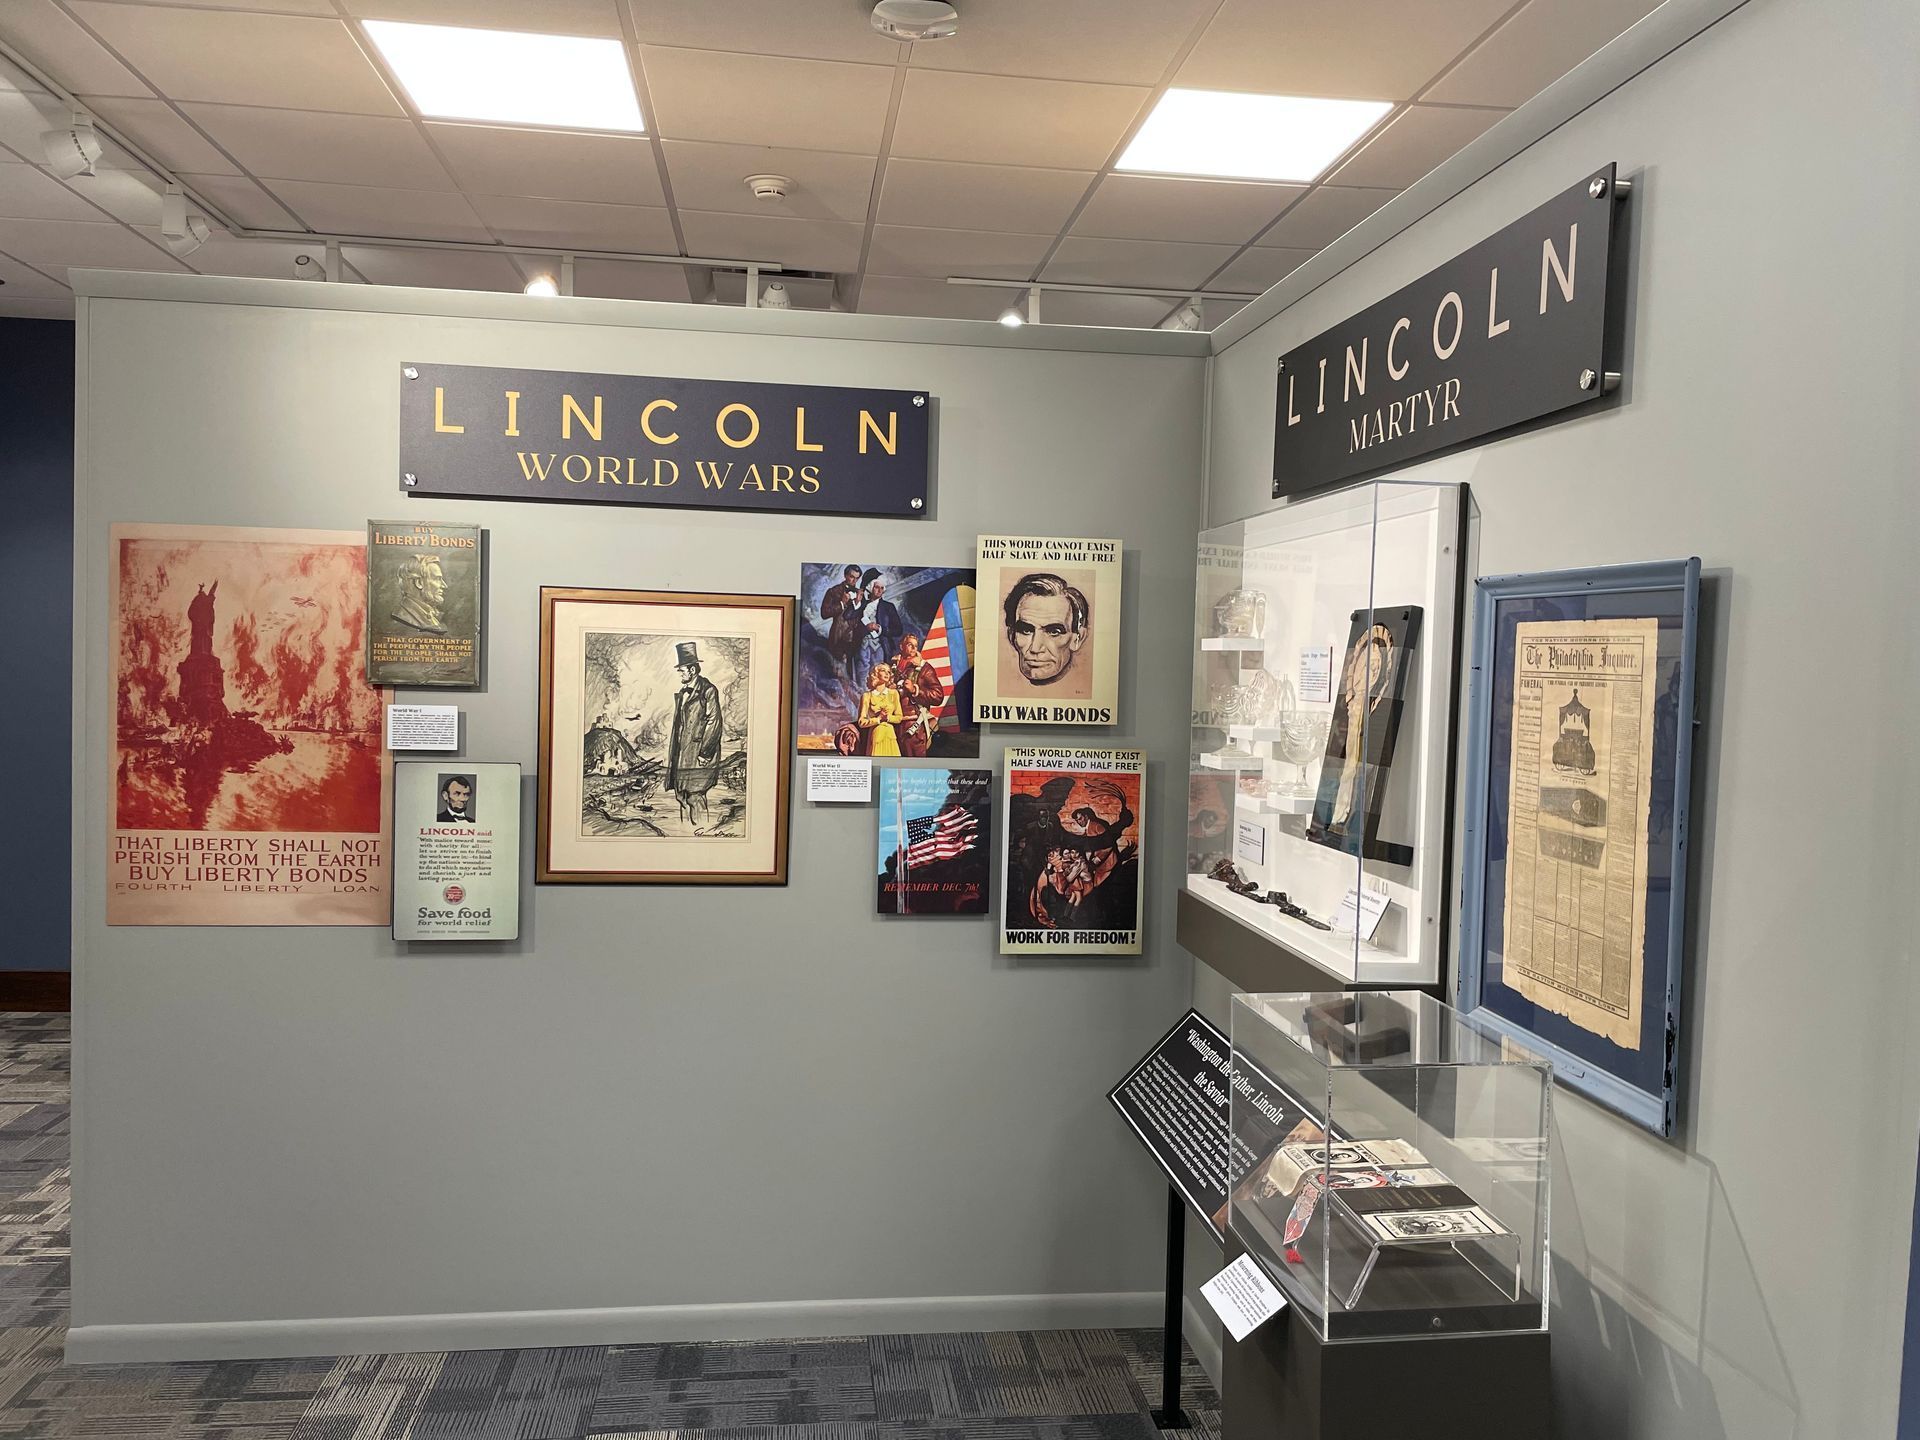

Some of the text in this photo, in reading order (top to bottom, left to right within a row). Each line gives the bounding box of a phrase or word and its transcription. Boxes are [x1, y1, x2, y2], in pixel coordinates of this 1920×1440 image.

[1288, 223, 1578, 427] LINCOLN
[435, 387, 896, 455] LINCOLN
[1350, 378, 1461, 453] MARTYR
[516, 452, 820, 493] WORLD WARS
[376, 532, 474, 548] LIBERTY BONDS
[984, 540, 1116, 551] THIS WORLD CANNOT EXIST
[1010, 551, 1038, 560] SLAVE
[1042, 552, 1060, 560] AND
[1065, 553, 1088, 561] HALF
[1092, 554, 1115, 562] FREE
[1526, 645, 1542, 669] The
[1549, 646, 1593, 670] Philadelphia
[1521, 679, 1542, 689] FUNERAL
[980, 705, 1110, 722] BUY WAR BONDS
[1012, 748, 1140, 760] "THIS WORLD CANNOT EXIST
[1011, 759, 1033, 767] HALF
[1036, 760, 1063, 768] SLAVE
[1067, 761, 1086, 769] AND
[1116, 762, 1142, 770] FREE"
[420, 828, 475, 836] LINCOLN
[116, 836, 380, 853] THAT LIBERTY SHALL NOT
[115, 851, 380, 867] PERISH FROM THE EARTH
[130, 866, 368, 883] BUY LIBERTY BONDS
[115, 883, 191, 891] FOURTH
[884, 883, 939, 892] REMEMBER
[418, 907, 491, 918] Save food
[1006, 931, 1043, 944] WORK
[1047, 931, 1069, 944] FOR
[1193, 1070, 1206, 1088] the
[1218, 1059, 1232, 1077] the
[1252, 1091, 1284, 1125] Lincoln
